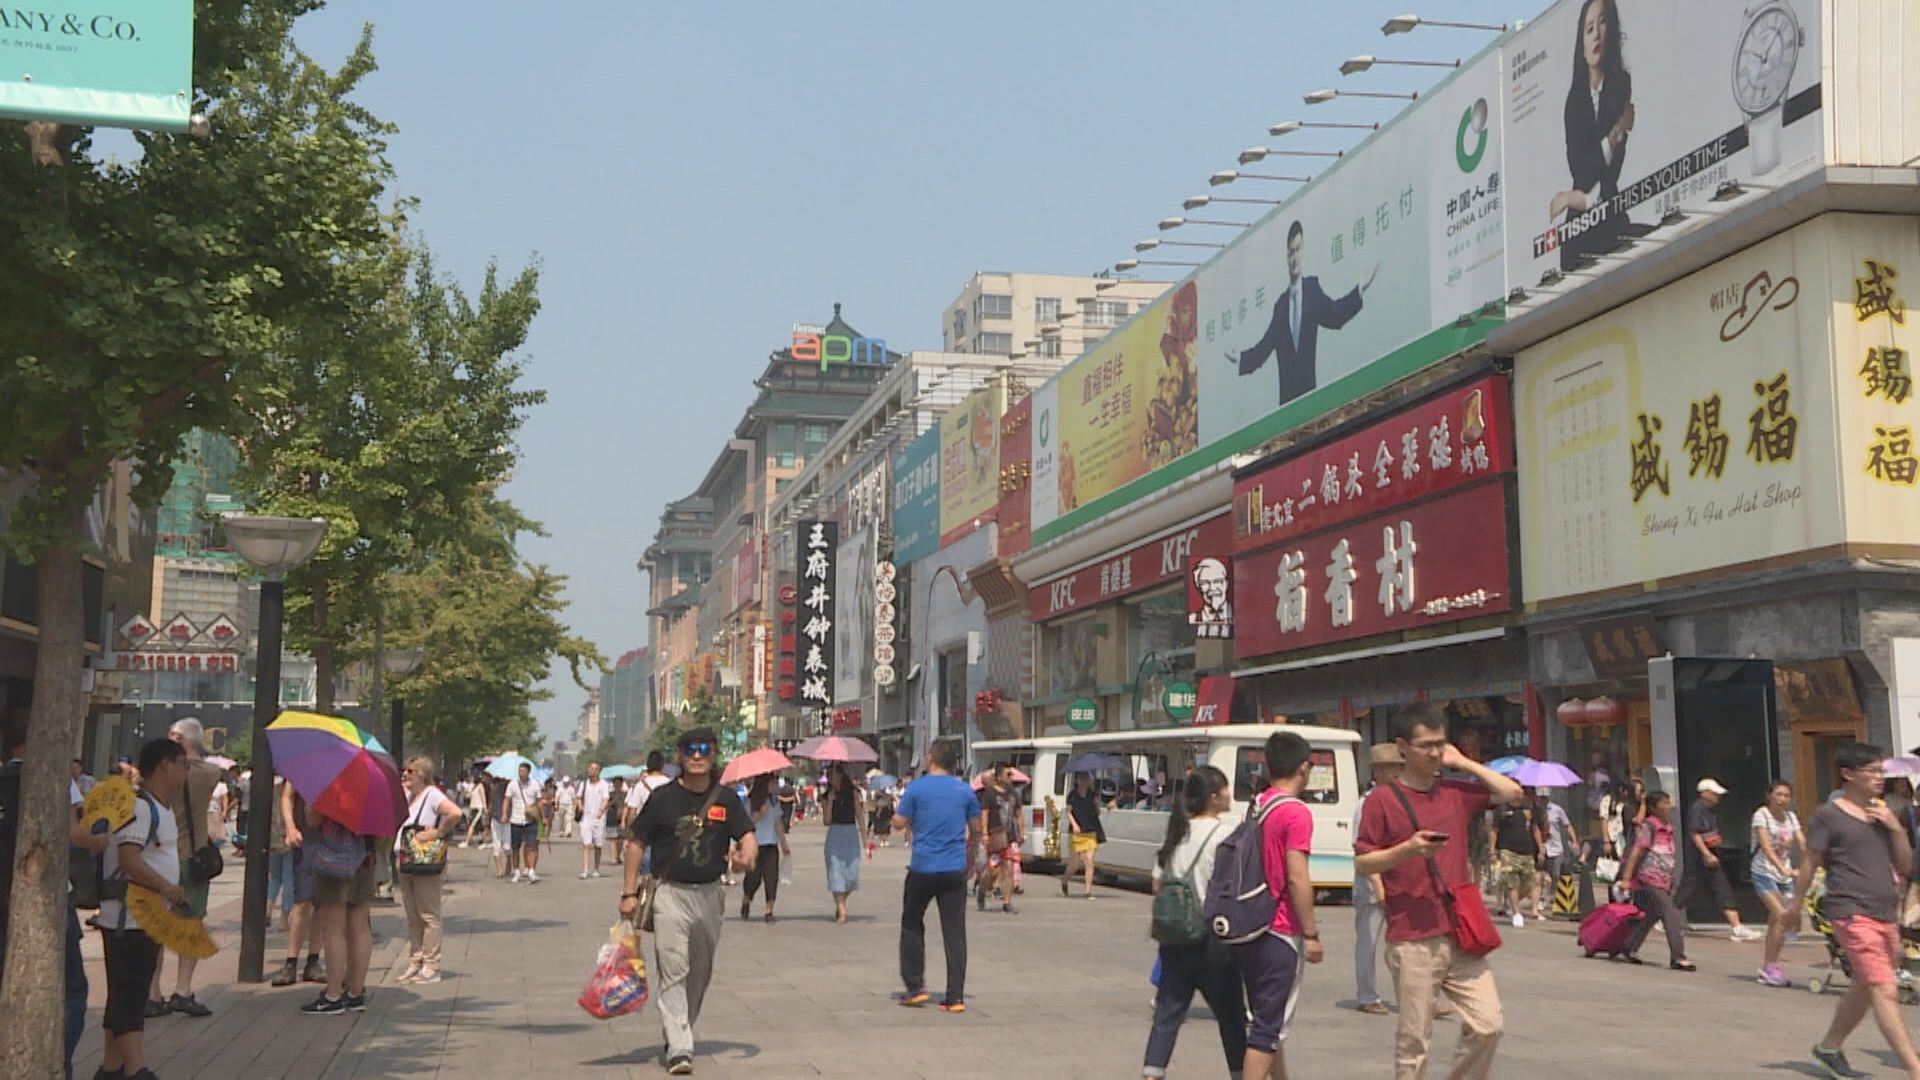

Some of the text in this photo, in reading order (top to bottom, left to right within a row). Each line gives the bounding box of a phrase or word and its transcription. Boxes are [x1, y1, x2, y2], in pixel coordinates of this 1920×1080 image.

[60, 13, 83, 37] &
[90, 15, 141, 42] Co.
[1557, 202, 1610, 242] TISSOT
[1611, 186, 1639, 214] THIS
[1640, 180, 1652, 201] IS
[1653, 156, 1692, 193] YOUR
[1694, 136, 1728, 171] TIME
[1447, 197, 1500, 238] CHINA LIFE
[791, 333, 886, 373] apm
[1641, 514, 1679, 536] Sheng
[1684, 504, 1698, 528] Xi
[1727, 490, 1758, 517] Hat
[1762, 481, 1803, 509] Shop
[1160, 528, 1199, 576] KFC
[1050, 575, 1077, 612] KFC
[1195, 703, 1218, 723] KFC
